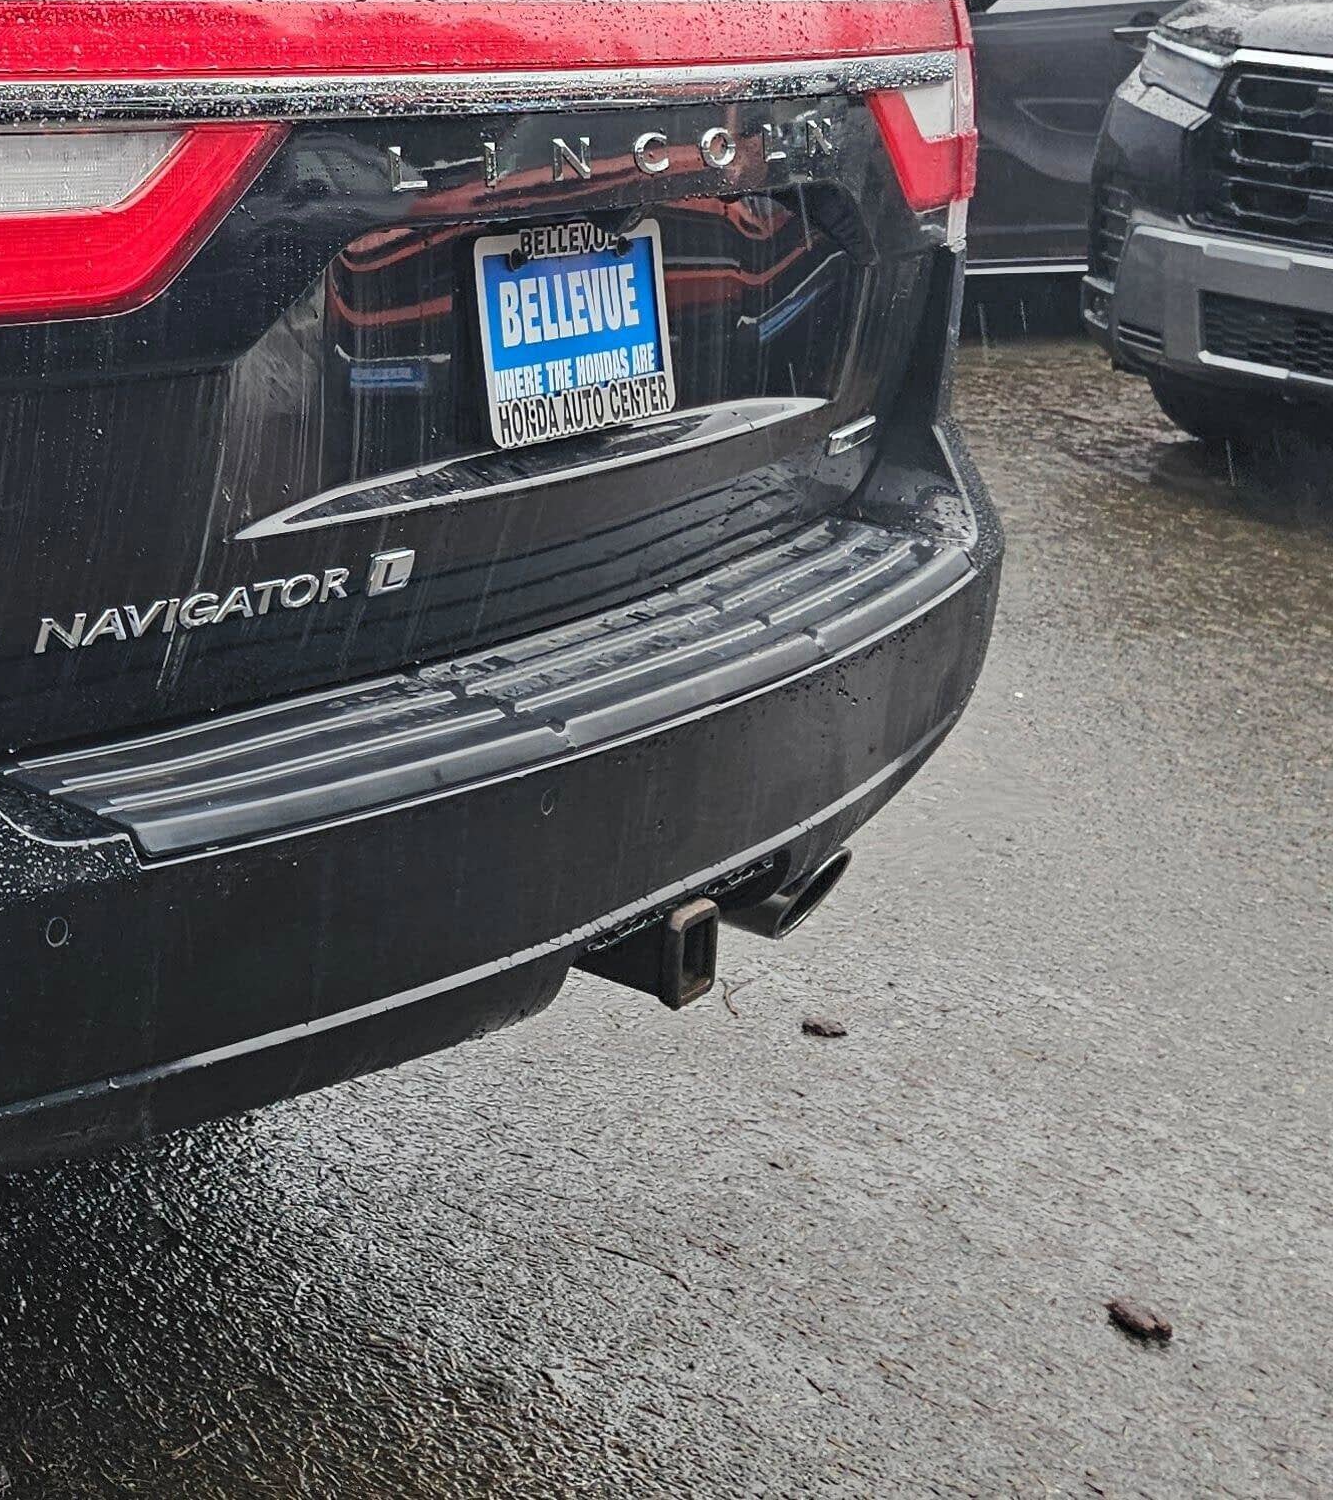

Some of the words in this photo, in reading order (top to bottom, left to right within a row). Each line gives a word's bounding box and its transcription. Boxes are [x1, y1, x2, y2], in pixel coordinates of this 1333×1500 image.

[389, 116, 834, 192] LINCOLN
[499, 264, 640, 348] BELLEVUE
[546, 358, 574, 391] THE
[576, 347, 630, 388] HONDAS
[632, 342, 656, 374] ARE
[498, 395, 561, 447] HONDA
[562, 386, 606, 434] AUTO
[608, 374, 671, 422] CENTER
[34, 566, 351, 654] NAVIGATOR
